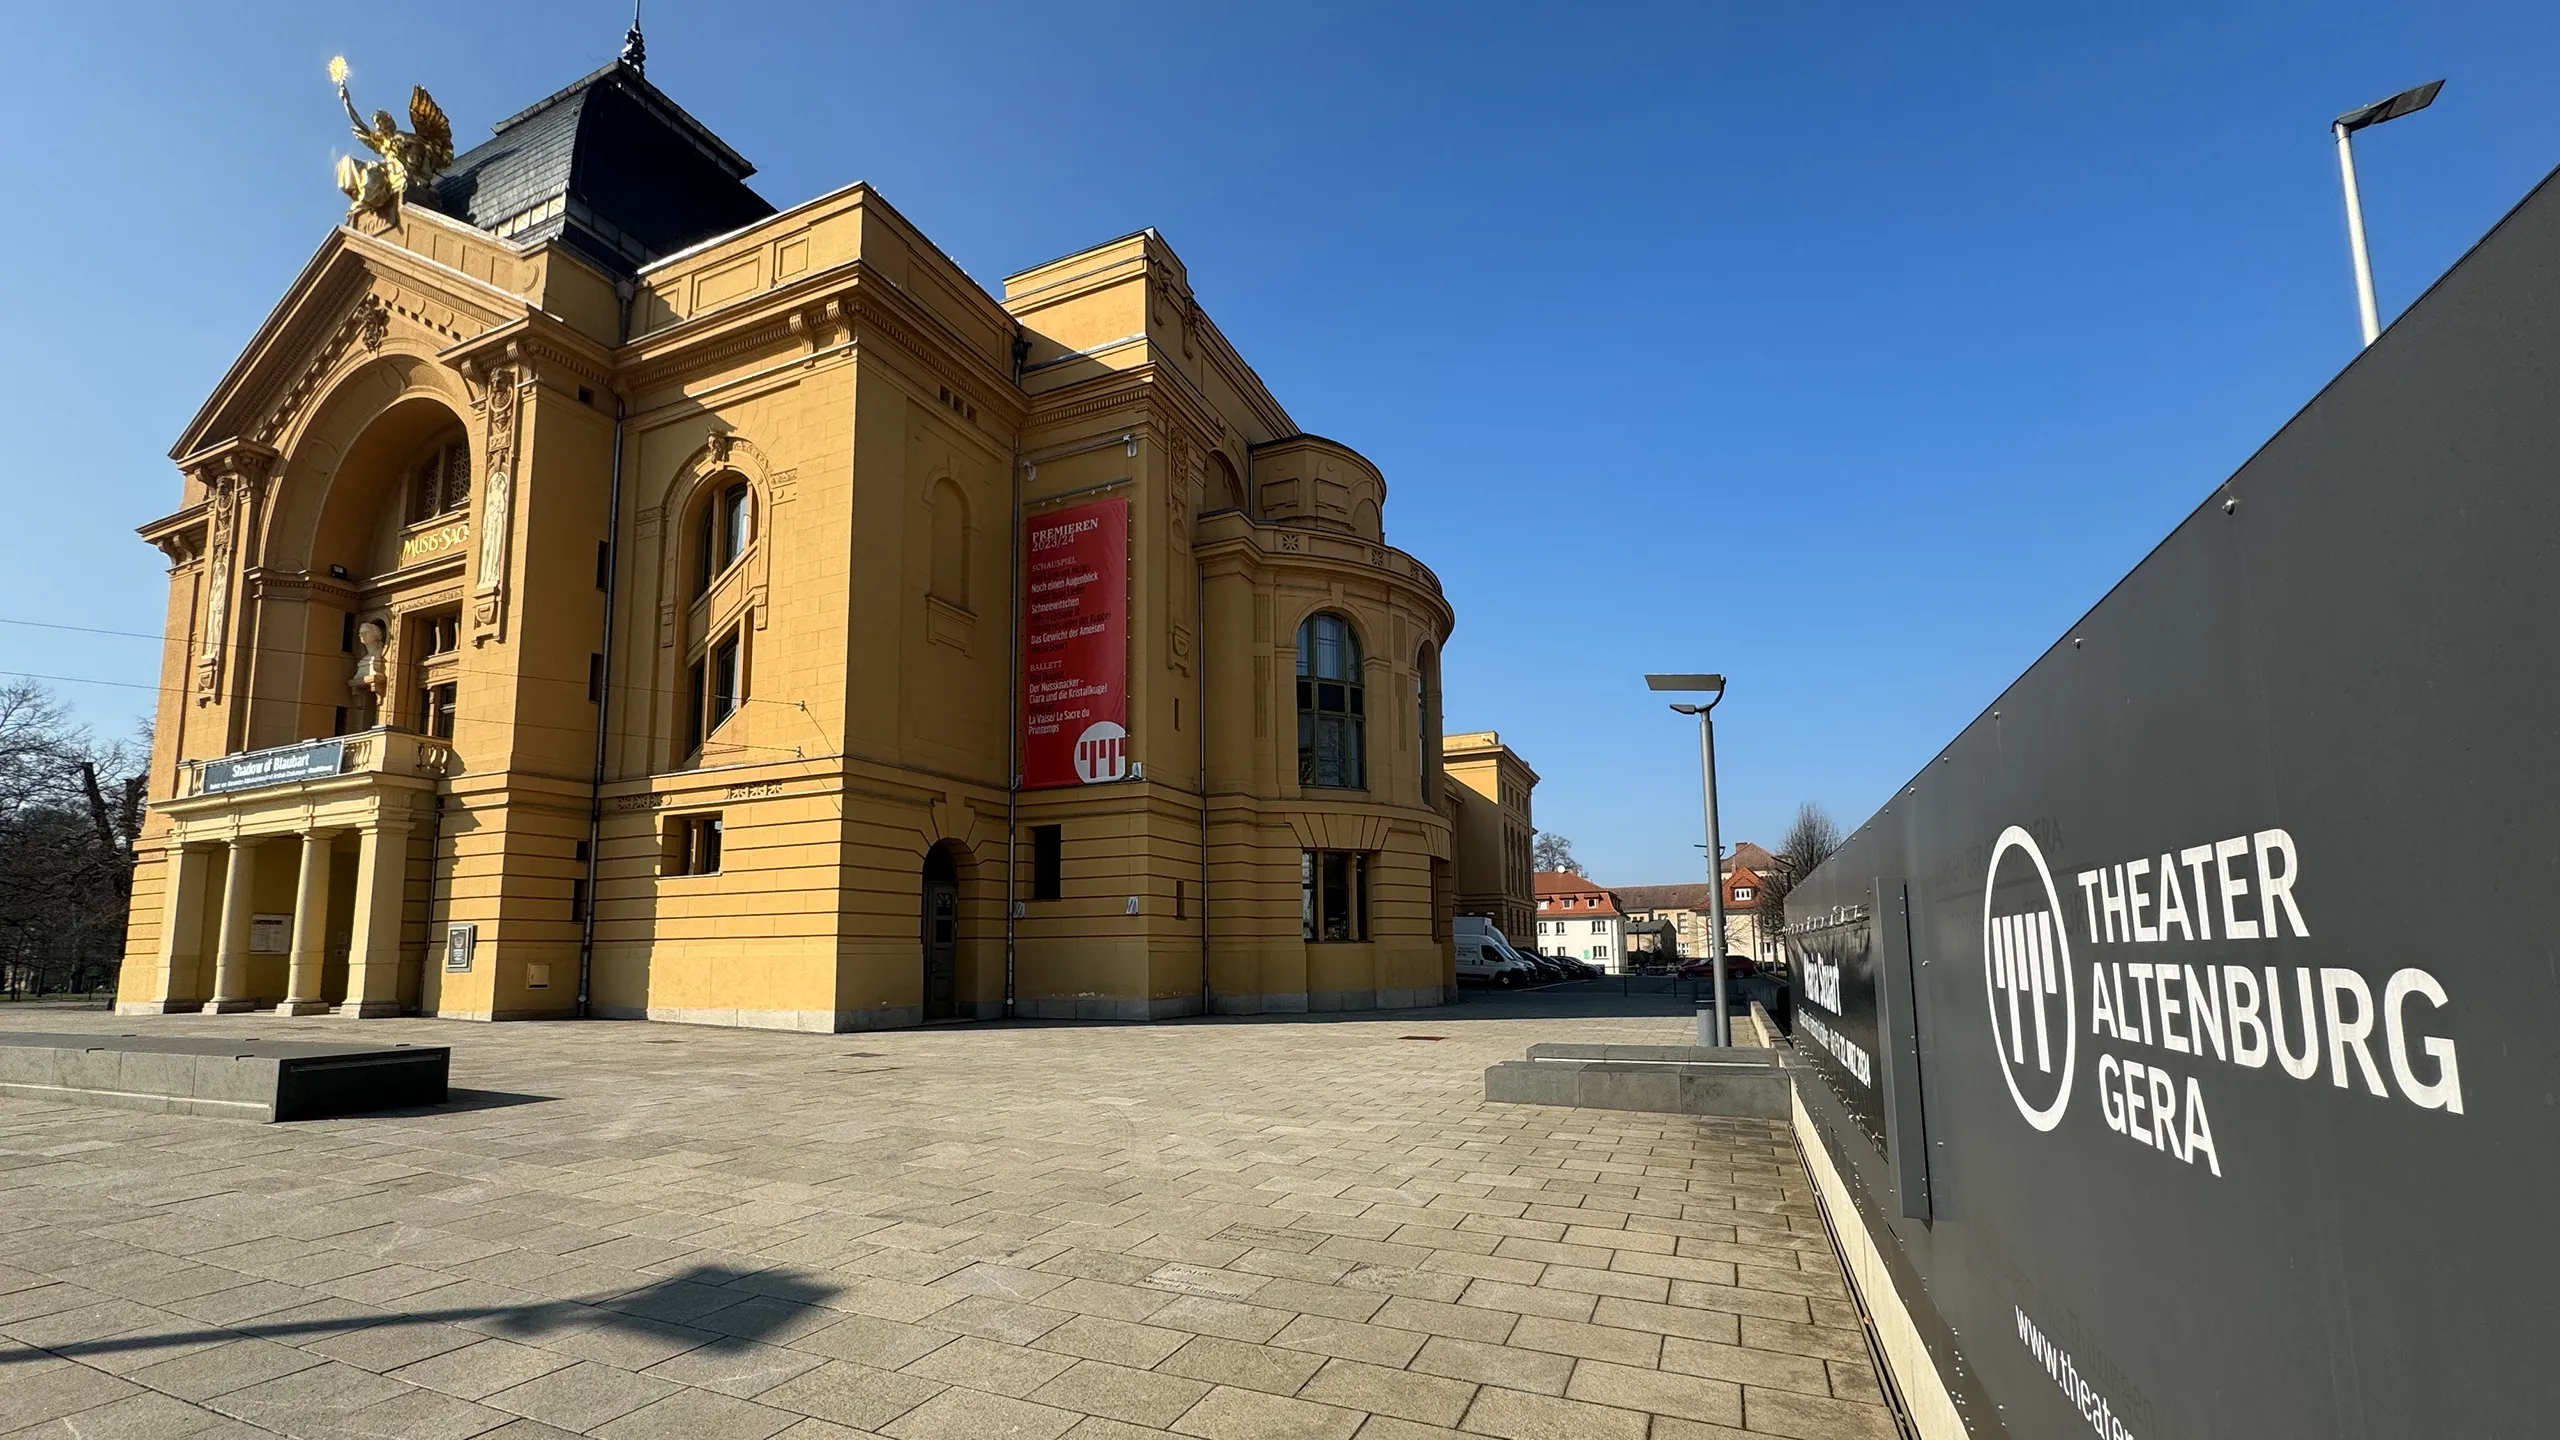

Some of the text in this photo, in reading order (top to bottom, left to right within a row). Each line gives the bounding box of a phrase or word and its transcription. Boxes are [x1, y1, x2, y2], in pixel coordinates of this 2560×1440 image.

[1032, 517, 1099, 542] PREMIEREN
[1032, 533, 1074, 552] 2023/24
[1032, 556, 1077, 572] SCHAUSPIEL
[1031, 583, 1047, 593] Noch
[1047, 579, 1065, 591] einen
[1065, 571, 1099, 587] Augenblick
[1031, 597, 1080, 614] Schneewittchen
[1031, 635, 1042, 645] Das
[1042, 630, 1068, 643] Gewicht
[1068, 628, 1079, 639] der
[1080, 623, 1105, 636] Ameisen
[1030, 660, 1063, 672] BALLETT
[1029, 683, 1040, 694] Der
[1041, 678, 1080, 692] Nussknacker
[1029, 683, 1108, 704] Clara und die Kristallkugel
[1028, 715, 1036, 725] La
[1056, 711, 1064, 721] Le
[1063, 709, 1081, 720] Sacre
[1081, 708, 1090, 717] du
[1028, 724, 1060, 735] Printemps
[232, 761, 263, 778] Shadow
[263, 758, 273, 773] of
[273, 753, 310, 770] Blaubart
[2077, 828, 2310, 944] THEATER
[2092, 962, 2465, 1116] ALTENBURG
[2099, 1053, 2222, 1178] GERA
